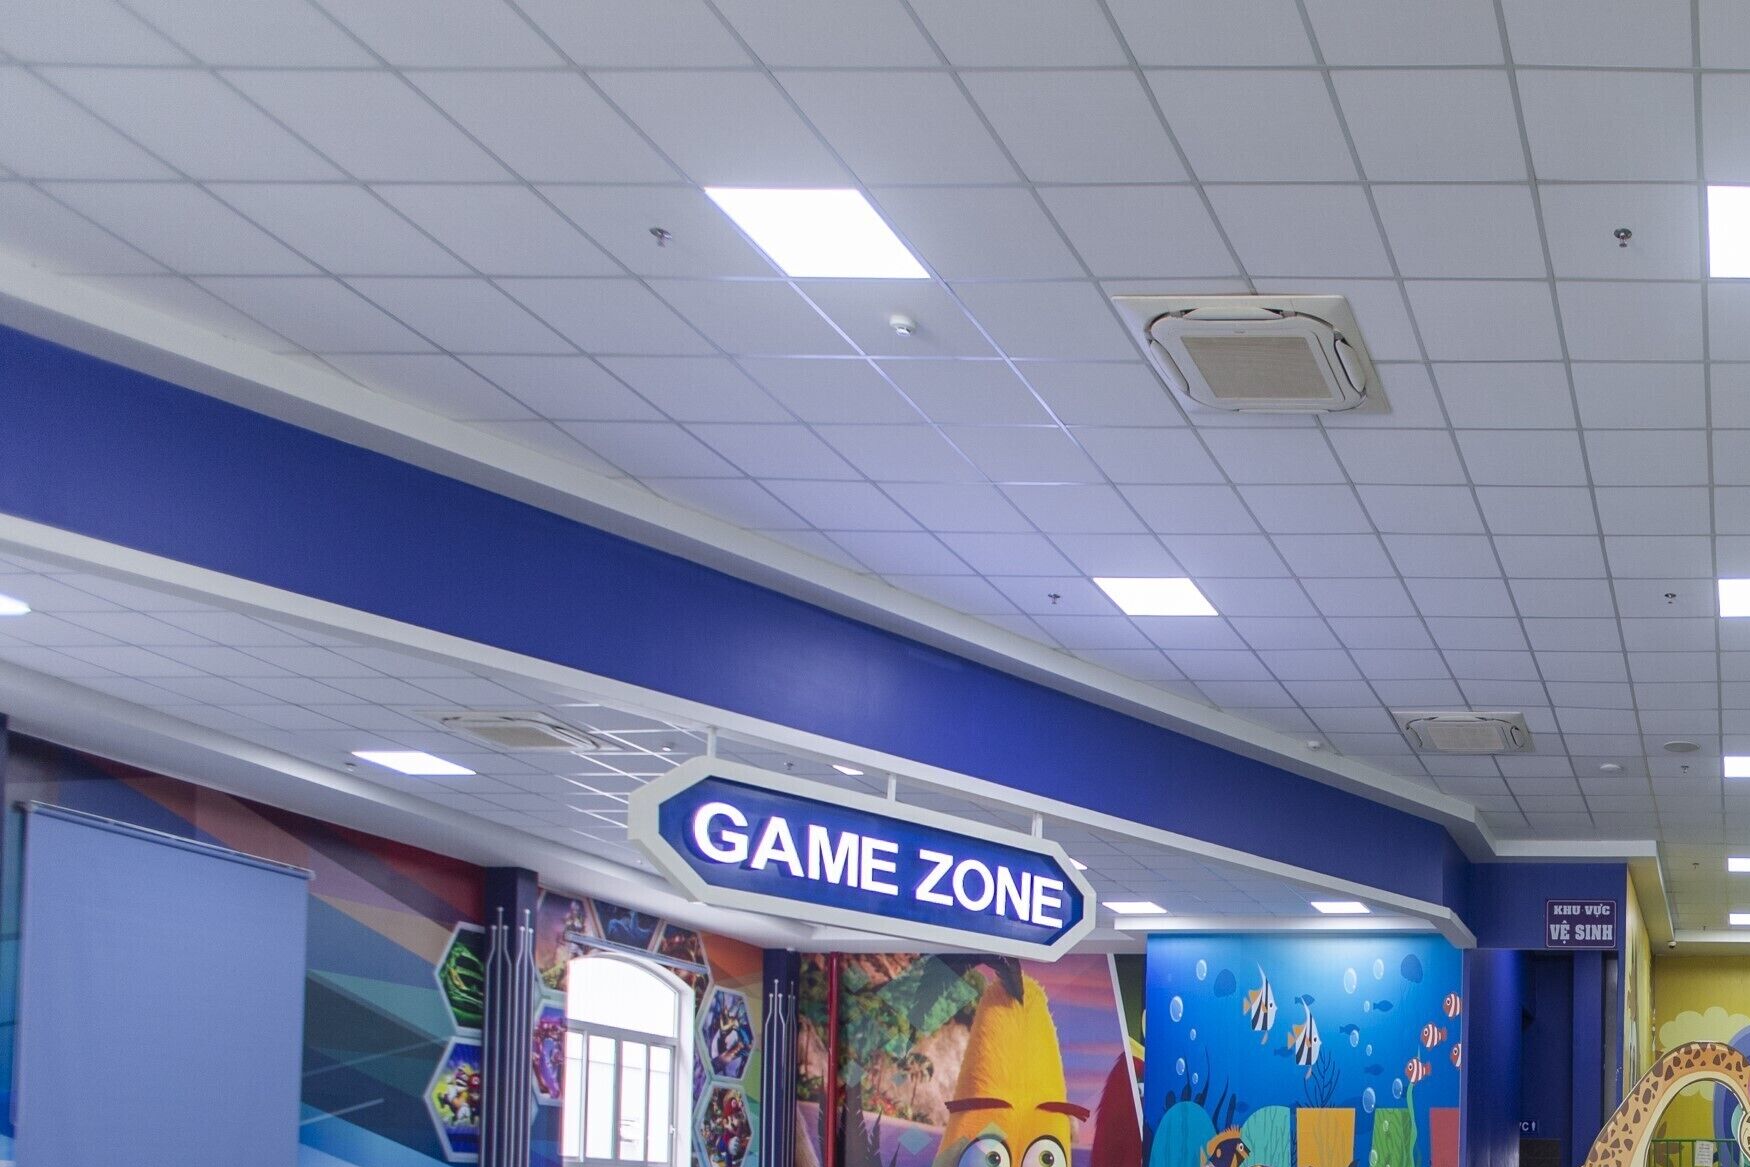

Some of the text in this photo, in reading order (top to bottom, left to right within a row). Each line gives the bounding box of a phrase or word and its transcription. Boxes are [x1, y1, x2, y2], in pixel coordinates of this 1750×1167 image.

[693, 801, 1064, 929] GAME ZONE
[1553, 903, 1610, 918] KHU VỰC
[1549, 920, 1613, 944] VỆ SINH
